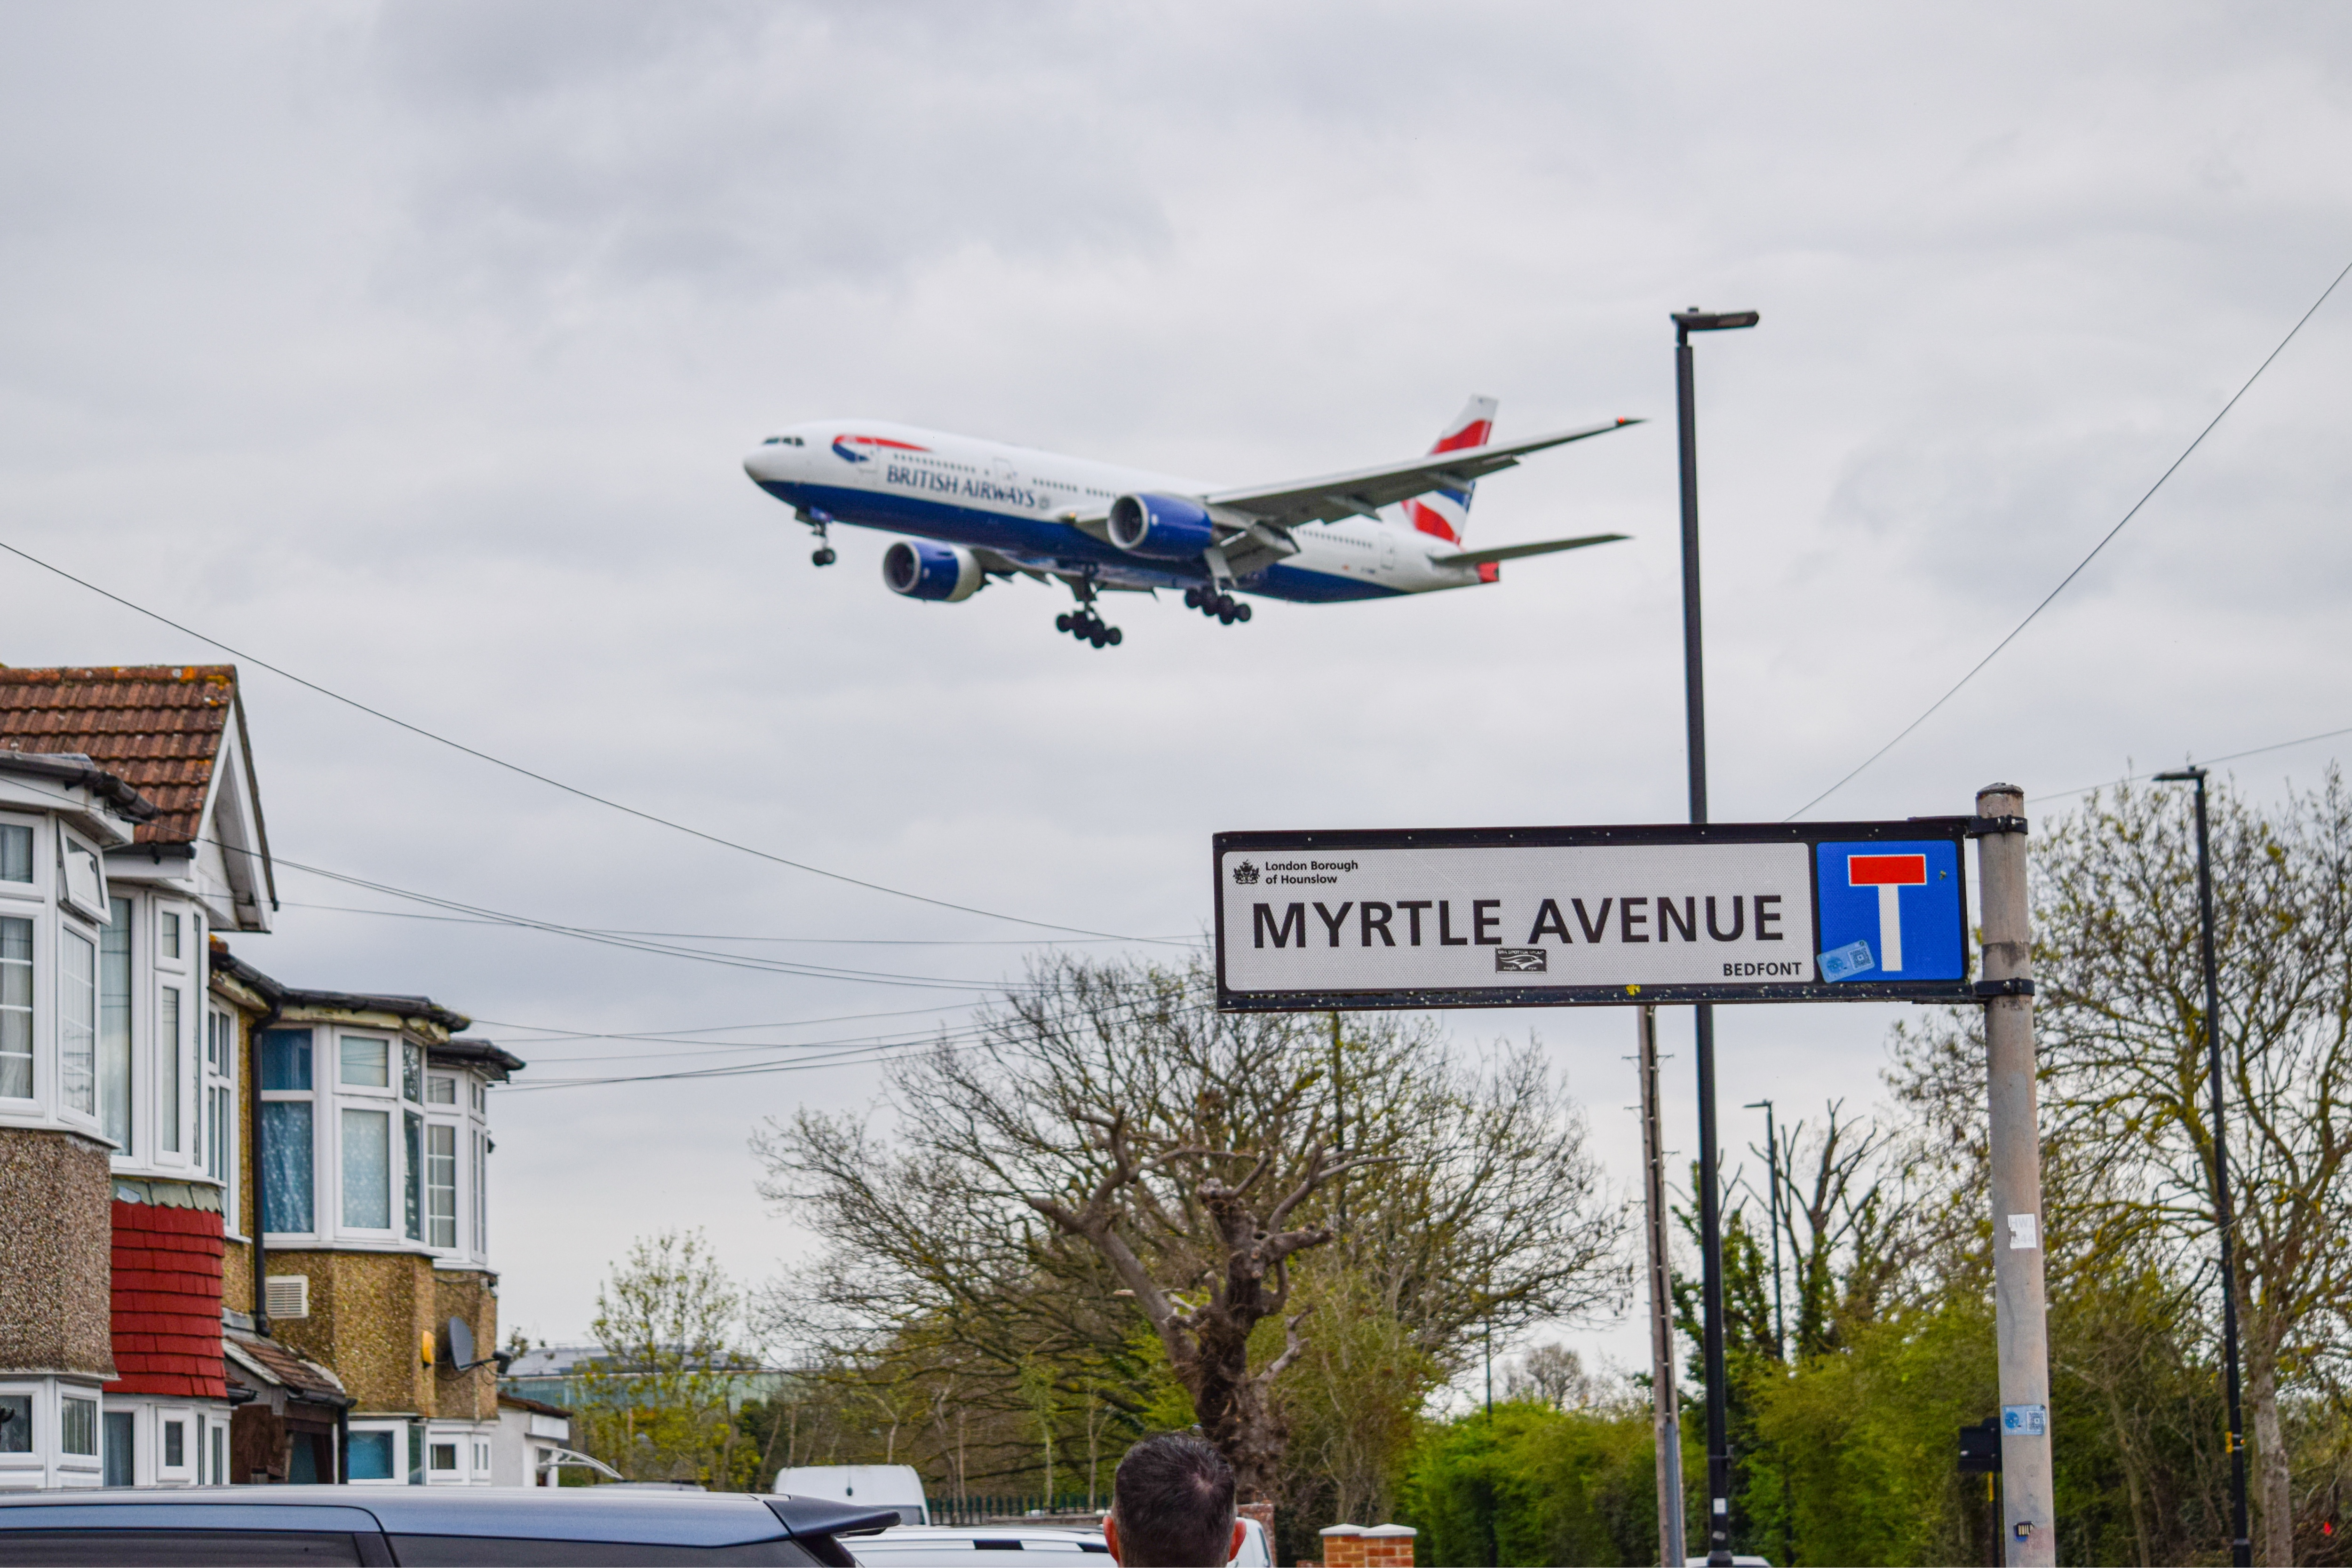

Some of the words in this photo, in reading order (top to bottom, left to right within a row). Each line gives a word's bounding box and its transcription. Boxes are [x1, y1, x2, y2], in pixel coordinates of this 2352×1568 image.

[887, 464, 959, 494] BRITISH
[961, 478, 1035, 508] AIRWAYS
[1265, 861, 1307, 871] London
[1311, 860, 1358, 872] Borough
[1265, 874, 1278, 884] of
[1281, 874, 1337, 884] Hounslow
[1253, 899, 1502, 948] MYRTLE
[1527, 895, 1783, 944] AVENUE
[1724, 962, 1802, 976] BEDFONT
